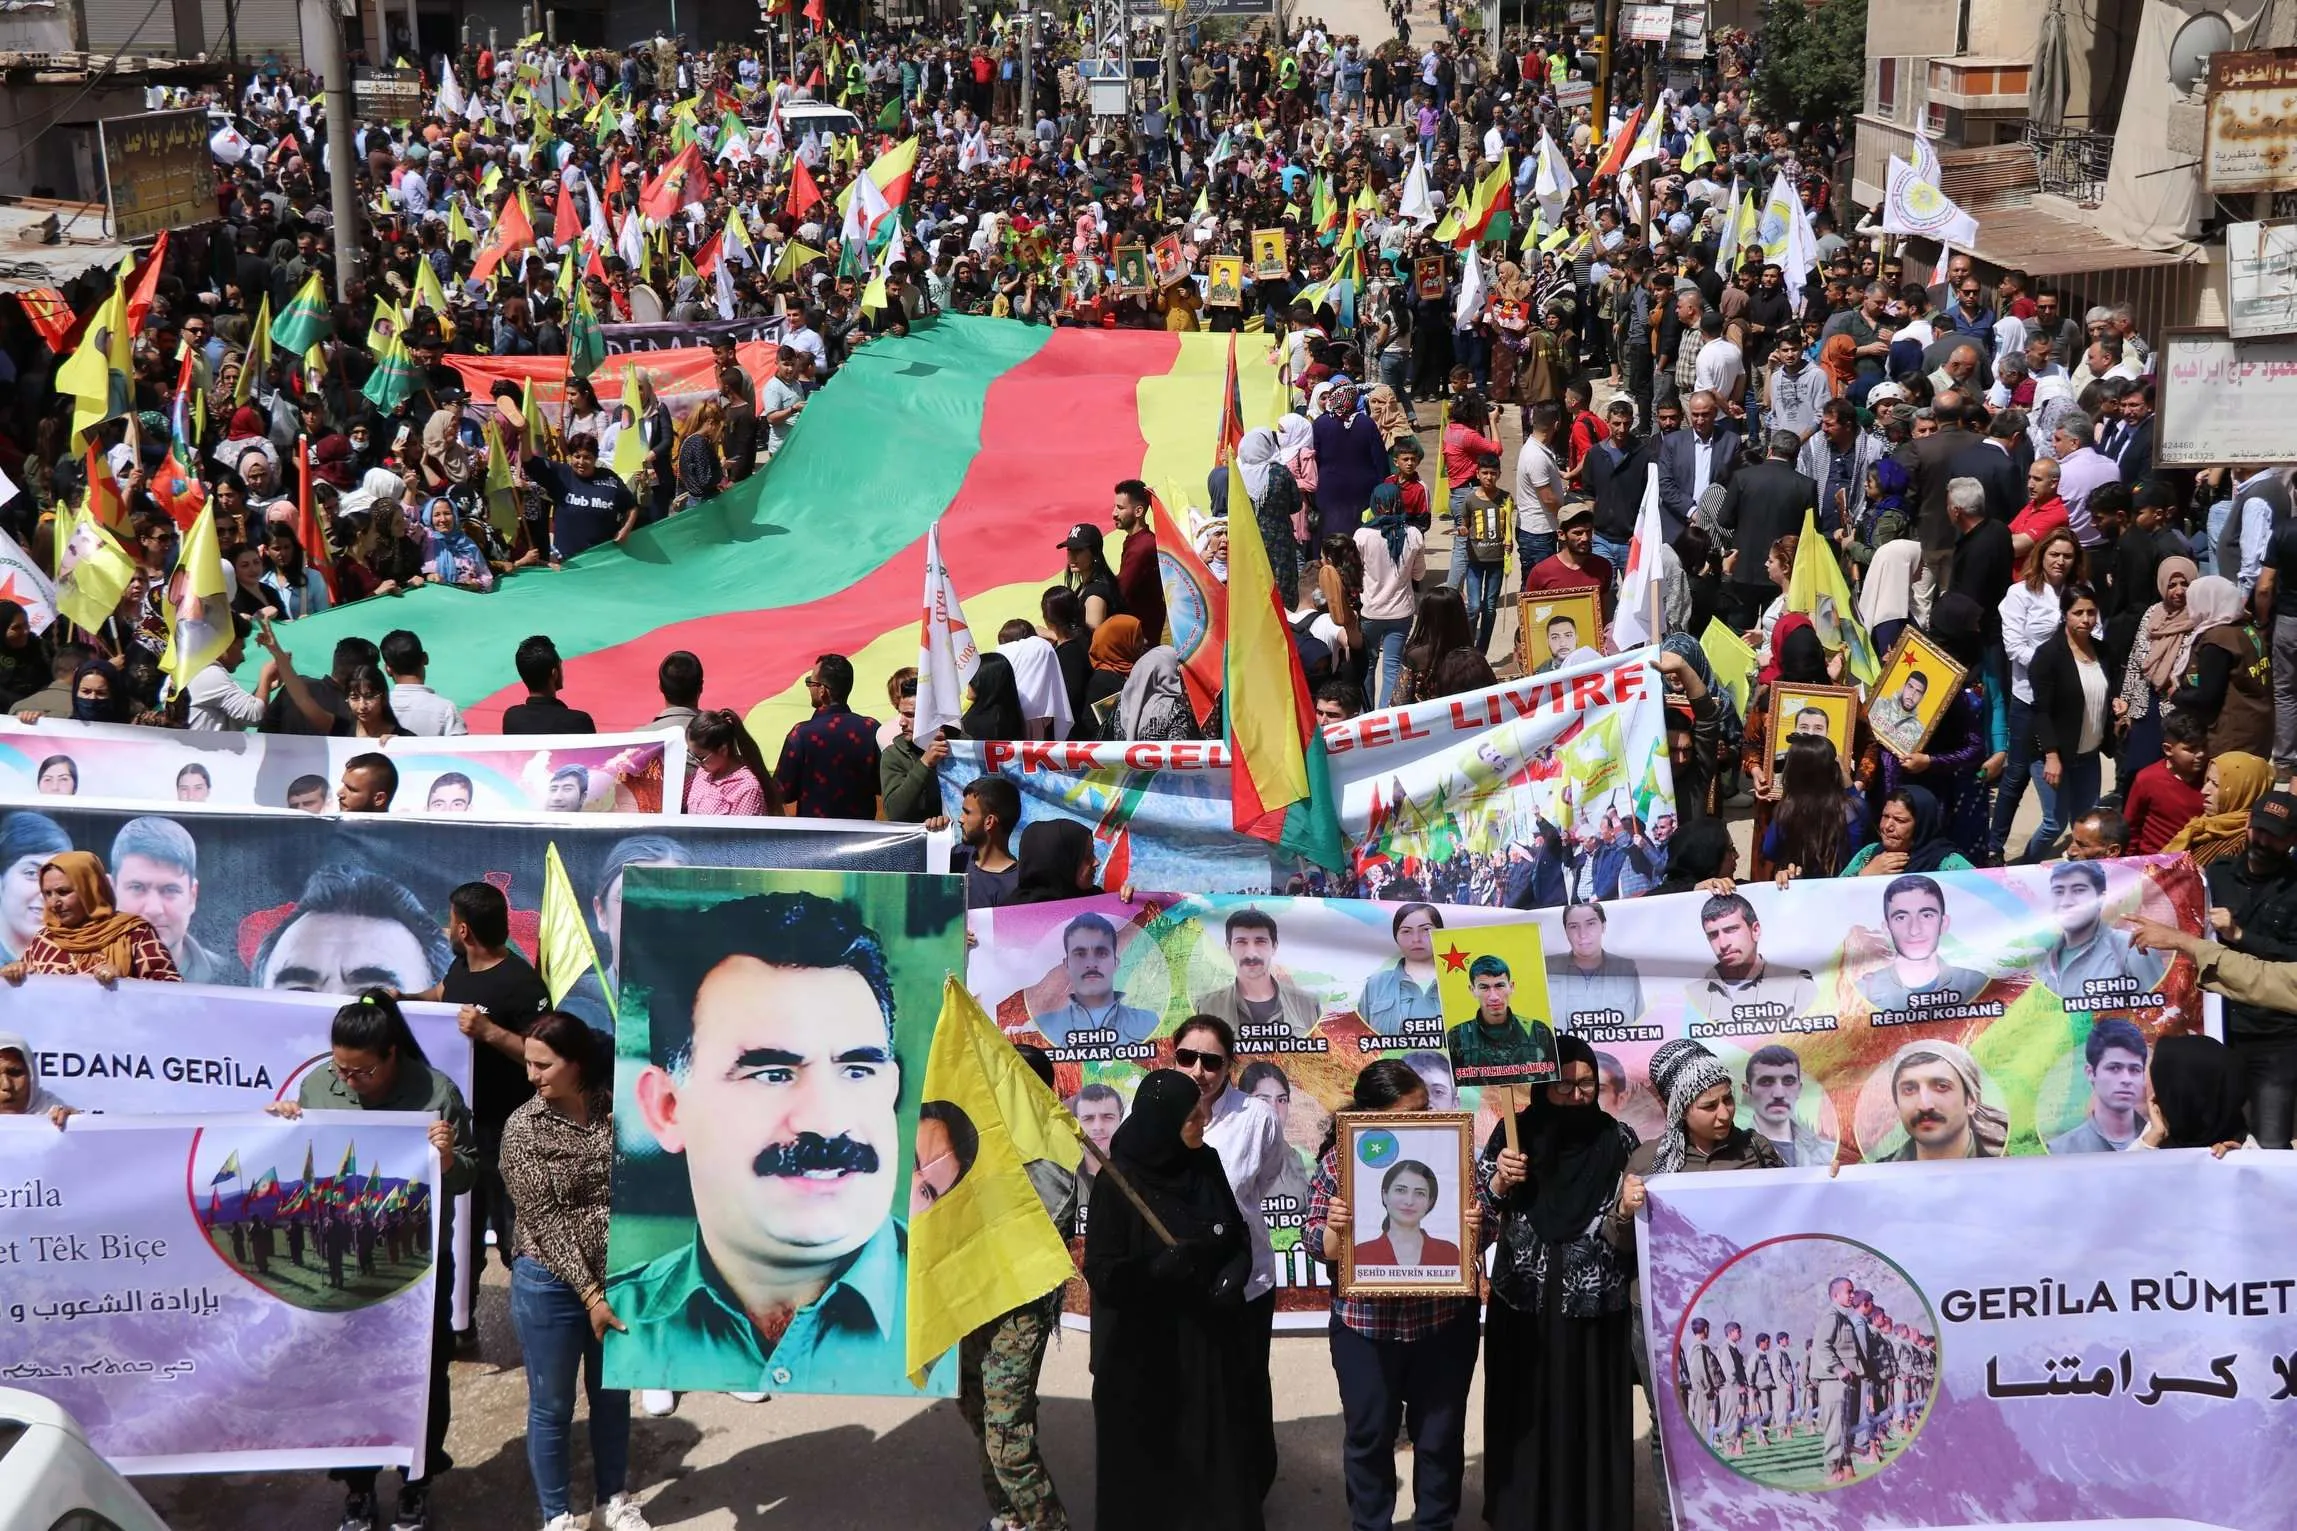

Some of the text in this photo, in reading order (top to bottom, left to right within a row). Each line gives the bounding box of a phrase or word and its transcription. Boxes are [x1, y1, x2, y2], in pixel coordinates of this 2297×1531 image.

[984, 662, 1648, 775] PKK GEL GEL LIVIRE
[1934, 1001, 2004, 1020] KOBANÊ
[1404, 1017, 1443, 1035] ŞEHÎ
[1593, 1026, 1662, 1041] RÛSTEM
[1780, 1017, 1836, 1034] LAŞER
[1044, 1047, 1111, 1062] EDAKAR
[1233, 1040, 1274, 1053] RVAN
[34, 1050, 274, 1090] EDANA GERÎLA
[0, 1179, 63, 1209] erîla
[1260, 1196, 1297, 1211] EHÎD
[1280, 1214, 1307, 1227] BO
[0, 1233, 168, 1265] et Têk Biçe
[1426, 1269, 1457, 1277] KELEF
[32, 1289, 142, 1322] الشعوب
[150, 1287, 219, 1316] بإرادة
[1941, 1270, 2296, 1323] GERÎLA RÛMET
[1985, 1348, 2239, 1406] كرامتنا
